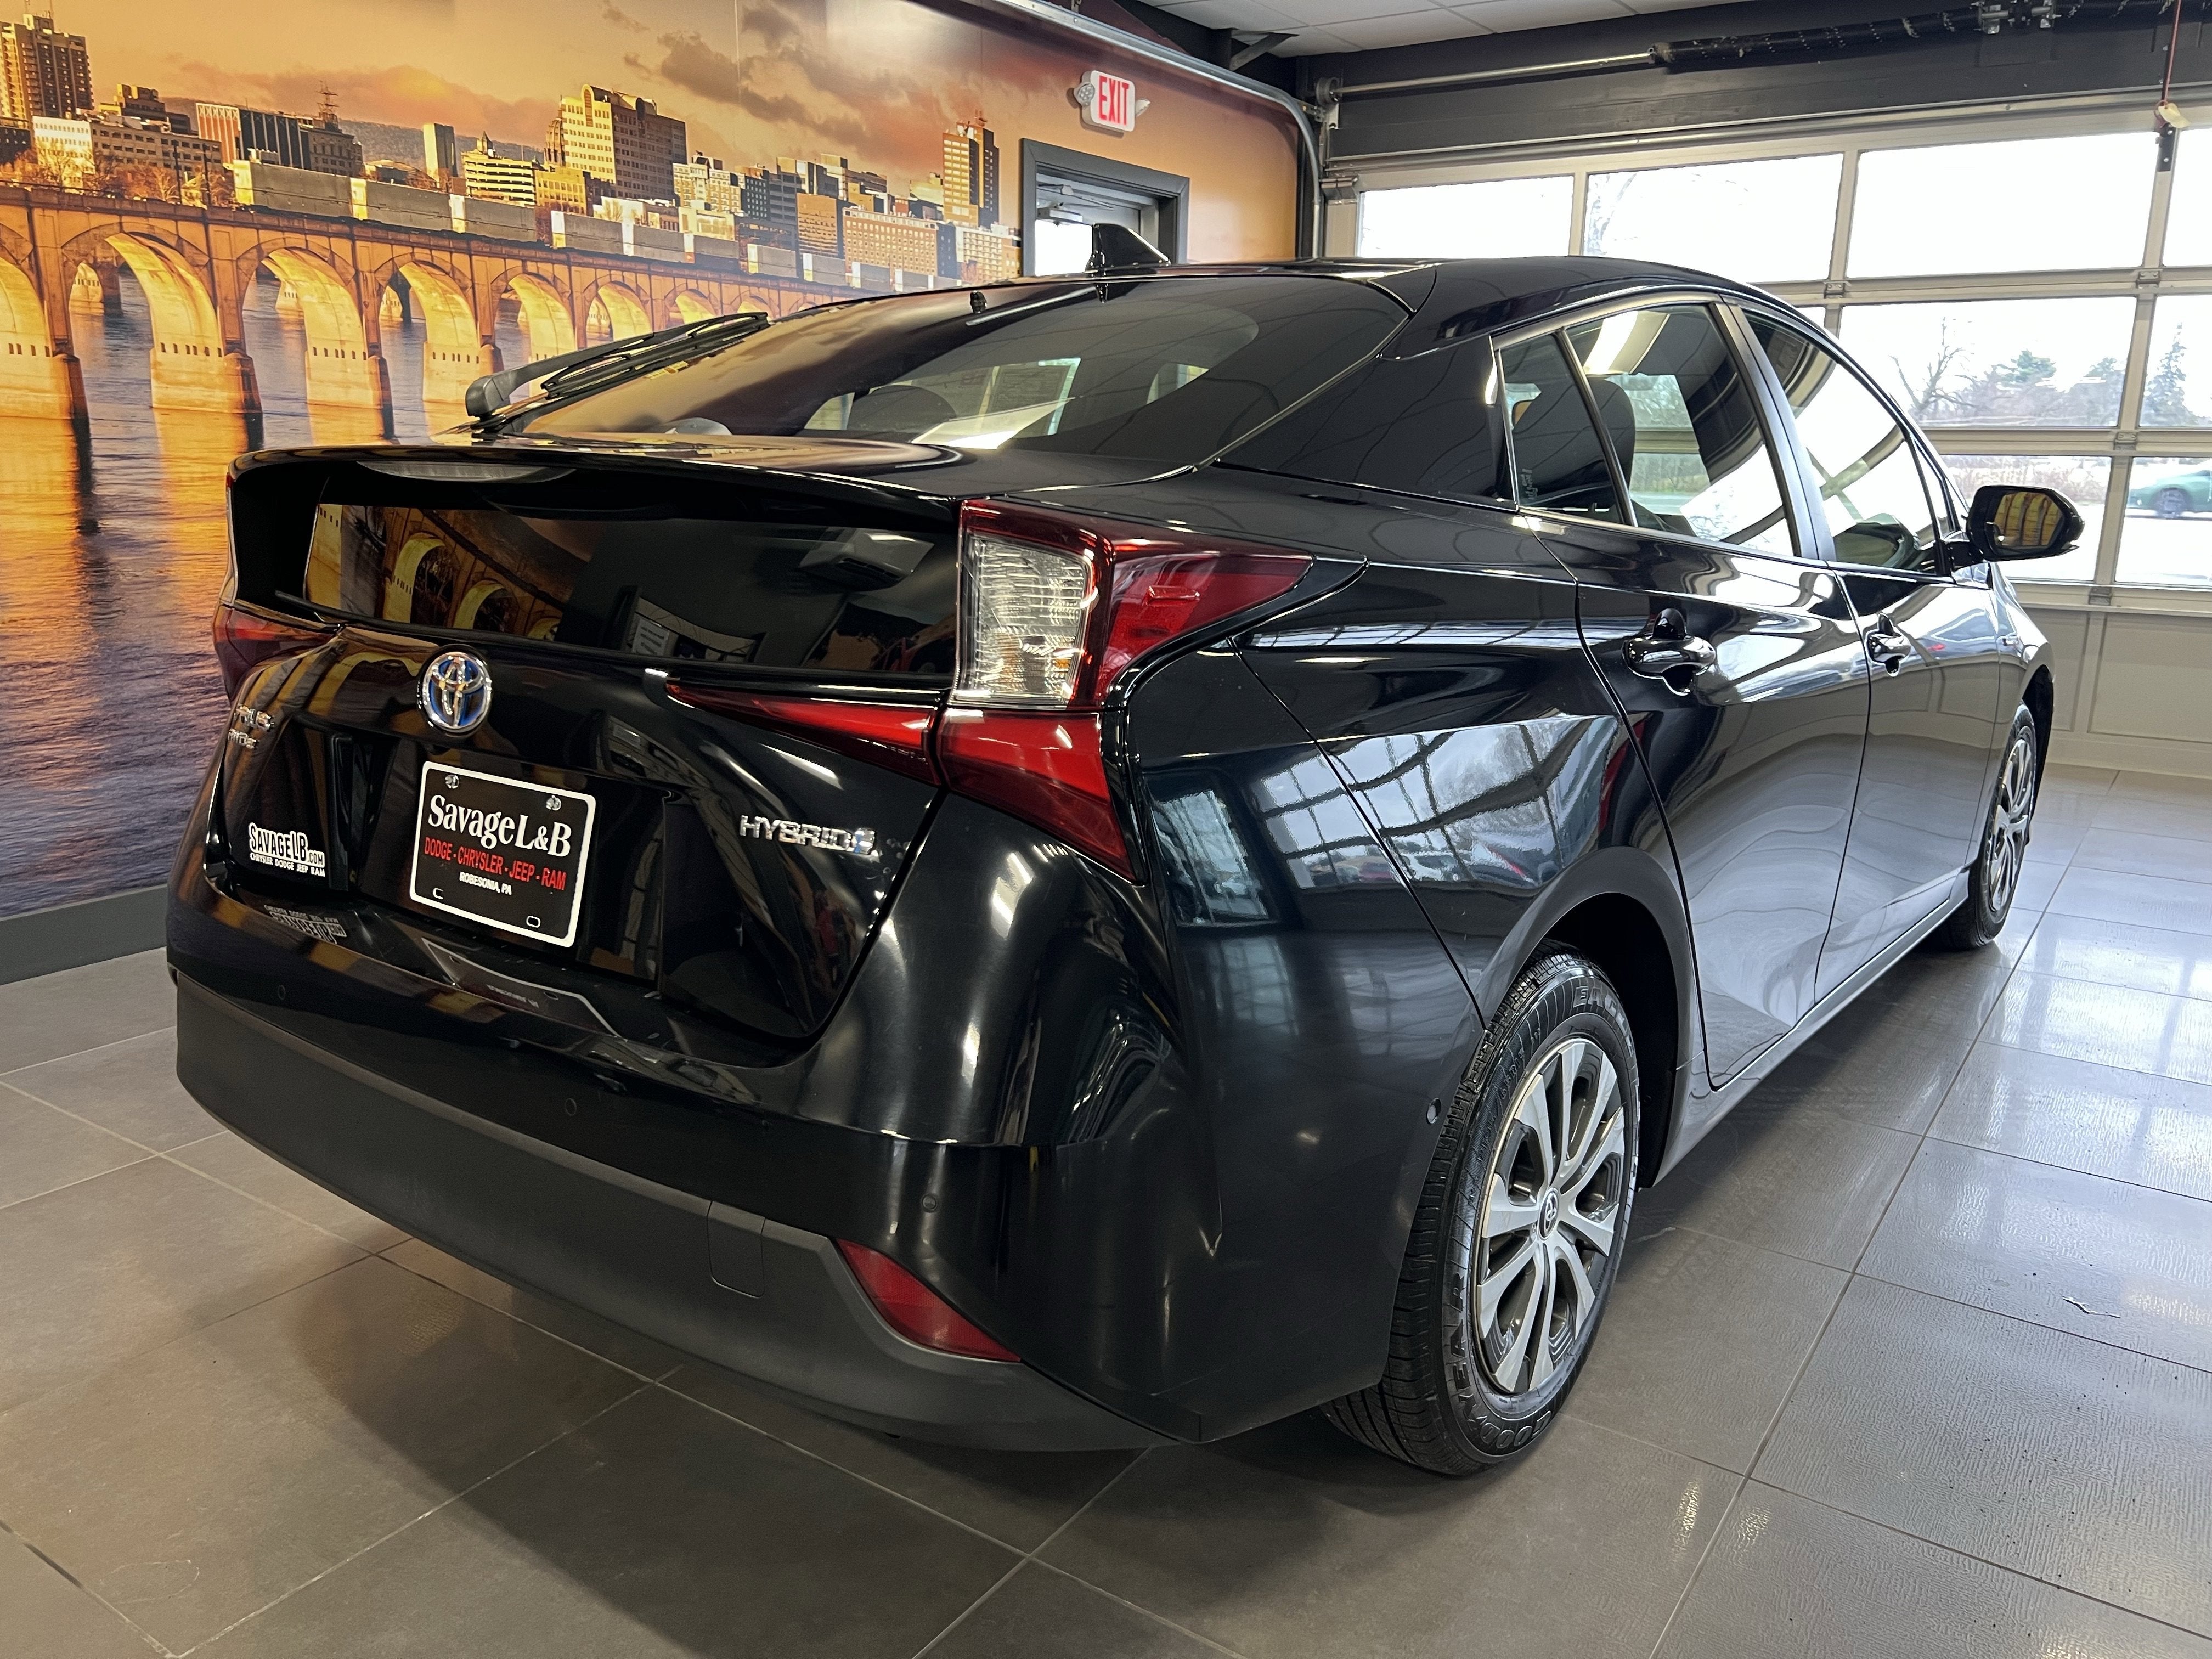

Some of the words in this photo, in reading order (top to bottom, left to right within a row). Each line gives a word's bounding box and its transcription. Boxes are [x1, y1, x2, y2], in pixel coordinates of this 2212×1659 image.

[1099, 75, 1130, 126] EXIT
[740, 815, 851, 851] HYBRID
[250, 852, 273, 865] CHRYSLER
[275, 858, 294, 870] DODGE
[296, 864, 308, 873] JEEP
[311, 866, 325, 877] RAM
[424, 837, 453, 861] DODGE
[458, 847, 504, 875] CHRYSLER
[509, 860, 535, 882] JEEP
[541, 867, 567, 891] RAM
[501, 882, 512, 895] PA
[1572, 985, 1634, 1058] EAGLE
[1450, 1272, 1553, 1449] GOODYEAR
